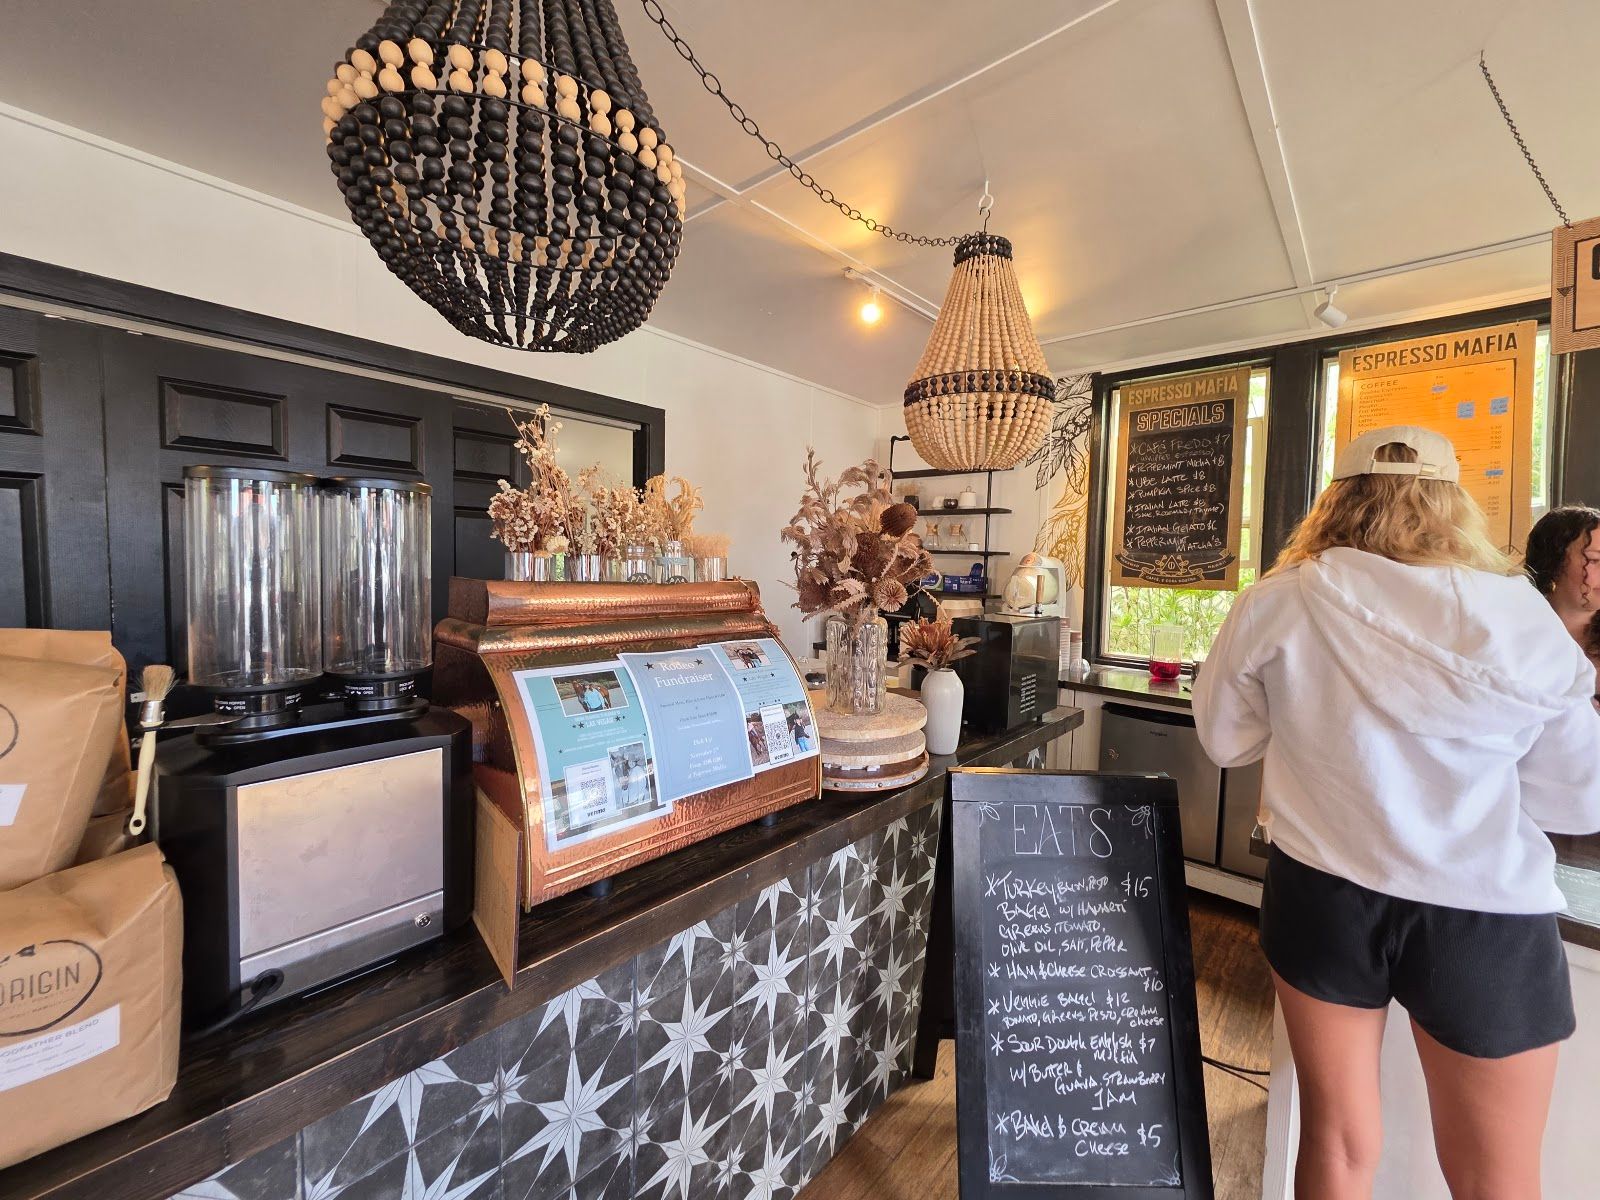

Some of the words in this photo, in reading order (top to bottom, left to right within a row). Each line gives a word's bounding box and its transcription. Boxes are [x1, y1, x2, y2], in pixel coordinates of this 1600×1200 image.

[1352, 342, 1448, 373] ESPRESSO
[1453, 331, 1518, 359] MAFIA
[1128, 382, 1192, 405] ESPRESSO
[1195, 375, 1238, 397] MAFIA
[1361, 380, 1399, 390] COFFEE
[1136, 403, 1225, 432] SPECIALS
[1193, 470, 1206, 480] $8
[1203, 483, 1217, 493] $8
[660, 661, 695, 672] Rodeo
[654, 672, 713, 688] Fundraiser
[1014, 804, 1113, 858] EATS
[1121, 872, 1152, 898] $15
[1006, 960, 1038, 980] HAM
[1143, 977, 1164, 992] $10
[1106, 989, 1130, 1008] $12
[65, 1018, 100, 1038] BLEND
[1138, 1032, 1156, 1055] $7
[1092, 1088, 1138, 1111] JAM
[1137, 1122, 1163, 1148] $5
